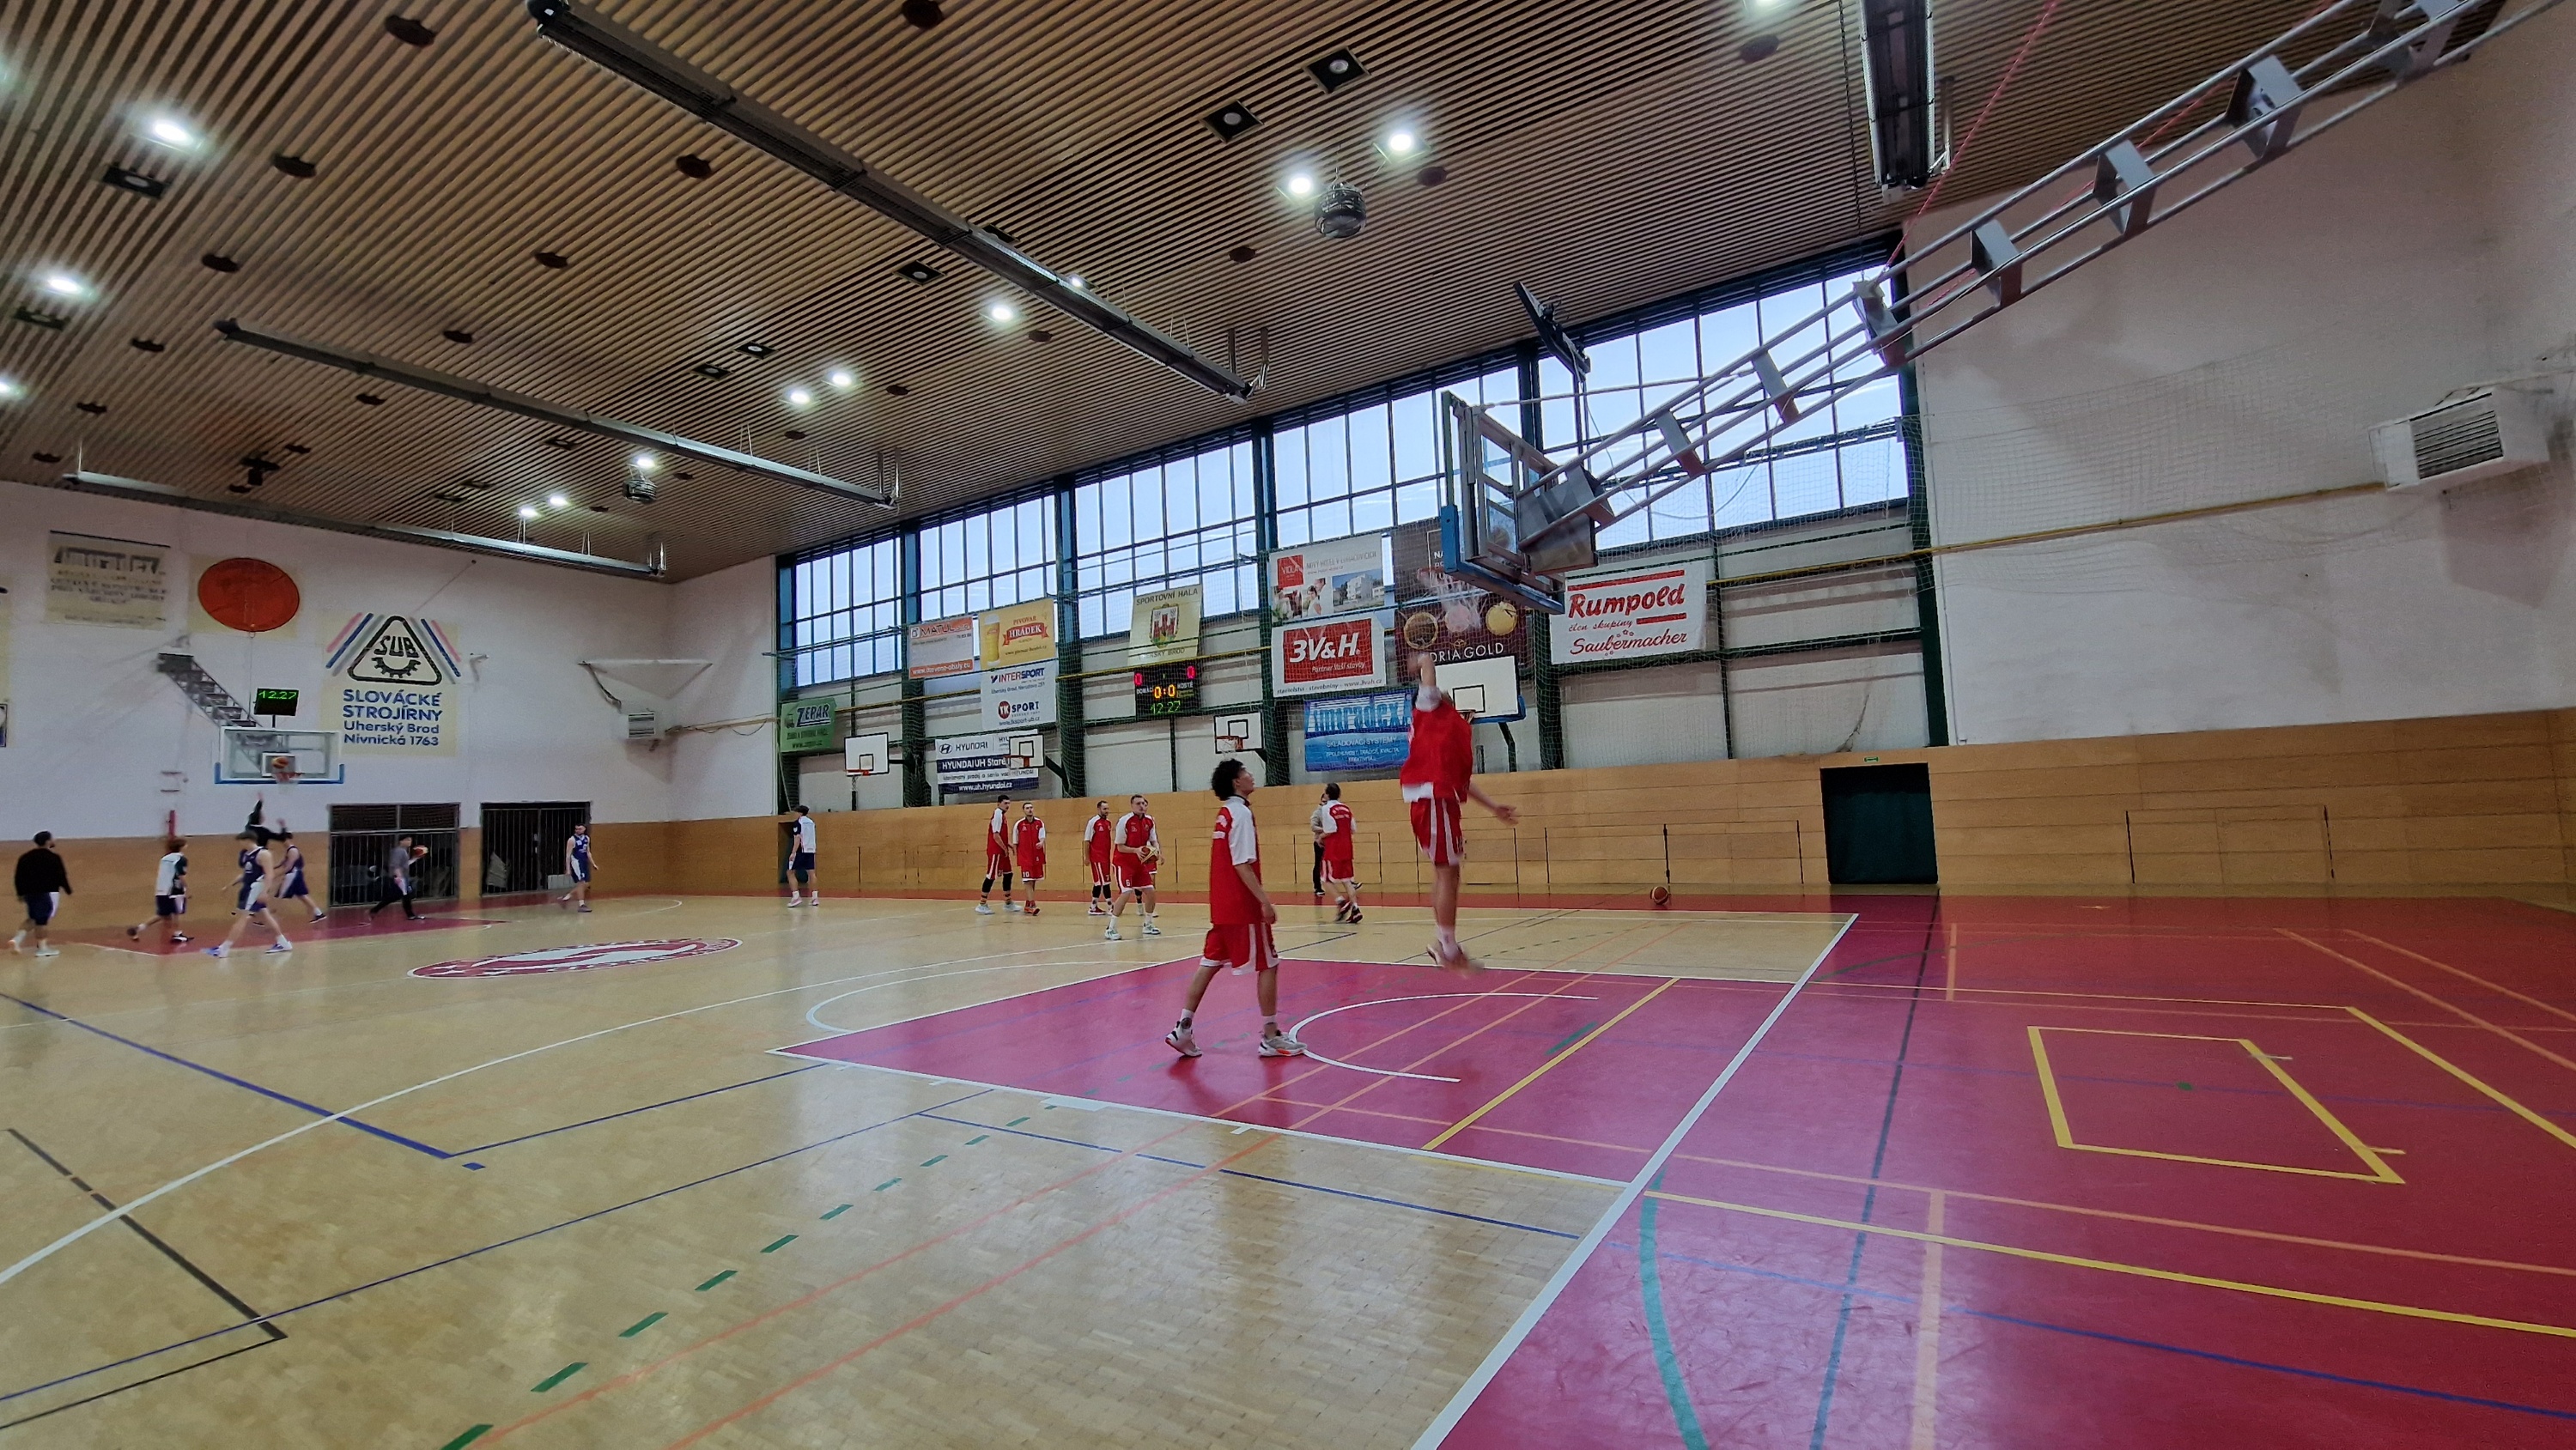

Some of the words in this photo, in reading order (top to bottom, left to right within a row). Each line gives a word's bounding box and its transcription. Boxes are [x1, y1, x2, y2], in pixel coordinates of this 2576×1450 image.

[1136, 591, 1176, 606] SPORTOVNÍ
[1178, 588, 1198, 598] HALA
[1568, 583, 1686, 618] Rumpold
[1013, 616, 1036, 625] PIVOVAR
[1568, 623, 1589, 632] člen
[1592, 619, 1634, 632] skupiny
[921, 623, 954, 636] MATUL
[1009, 624, 1042, 638] HRÁDEK
[374, 635, 419, 658] SUB
[1570, 628, 1688, 655] Saubermacher
[1429, 648, 1461, 663] DRIA
[1463, 642, 1504, 658] GOLD
[999, 668, 1045, 683] INTERSPORT
[343, 689, 442, 707] SLOVÁCKÉ
[343, 705, 443, 721] STROJÍRNY
[1012, 701, 1039, 713] SPORT
[796, 704, 829, 727] ZEPAR
[343, 720, 404, 734] Uherský
[407, 723, 439, 734] Brod
[343, 734, 405, 745] Nivnická
[410, 736, 439, 746] 1763
[956, 741, 988, 751] HYUNDAI
[942, 759, 975, 770] HYUNDAI
[975, 758, 986, 767] UH
